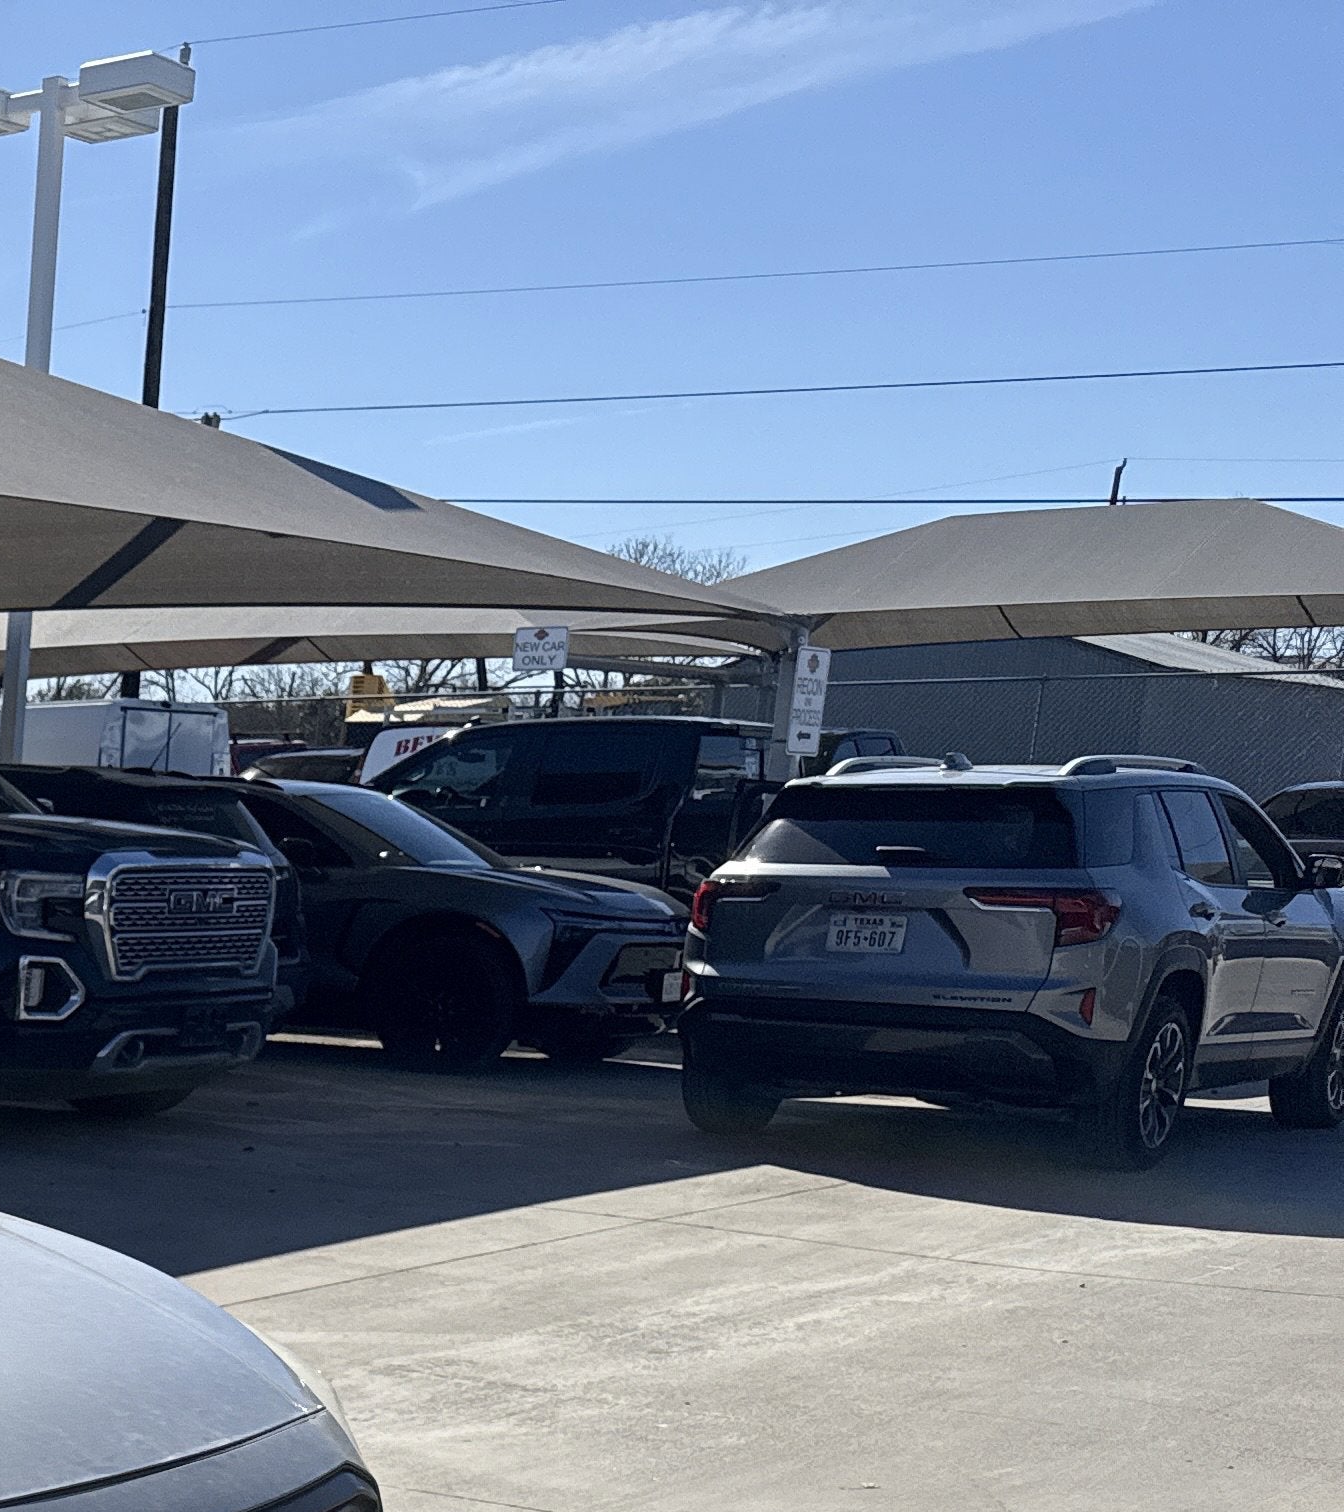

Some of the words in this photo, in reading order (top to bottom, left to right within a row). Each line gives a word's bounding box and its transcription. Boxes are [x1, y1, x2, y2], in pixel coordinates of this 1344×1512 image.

[515, 641, 540, 652] NEW
[542, 641, 565, 652] CAR
[521, 655, 557, 666] ONLY
[170, 890, 234, 912] GMC
[829, 890, 906, 905] GMC
[854, 917, 884, 926] TEXAS
